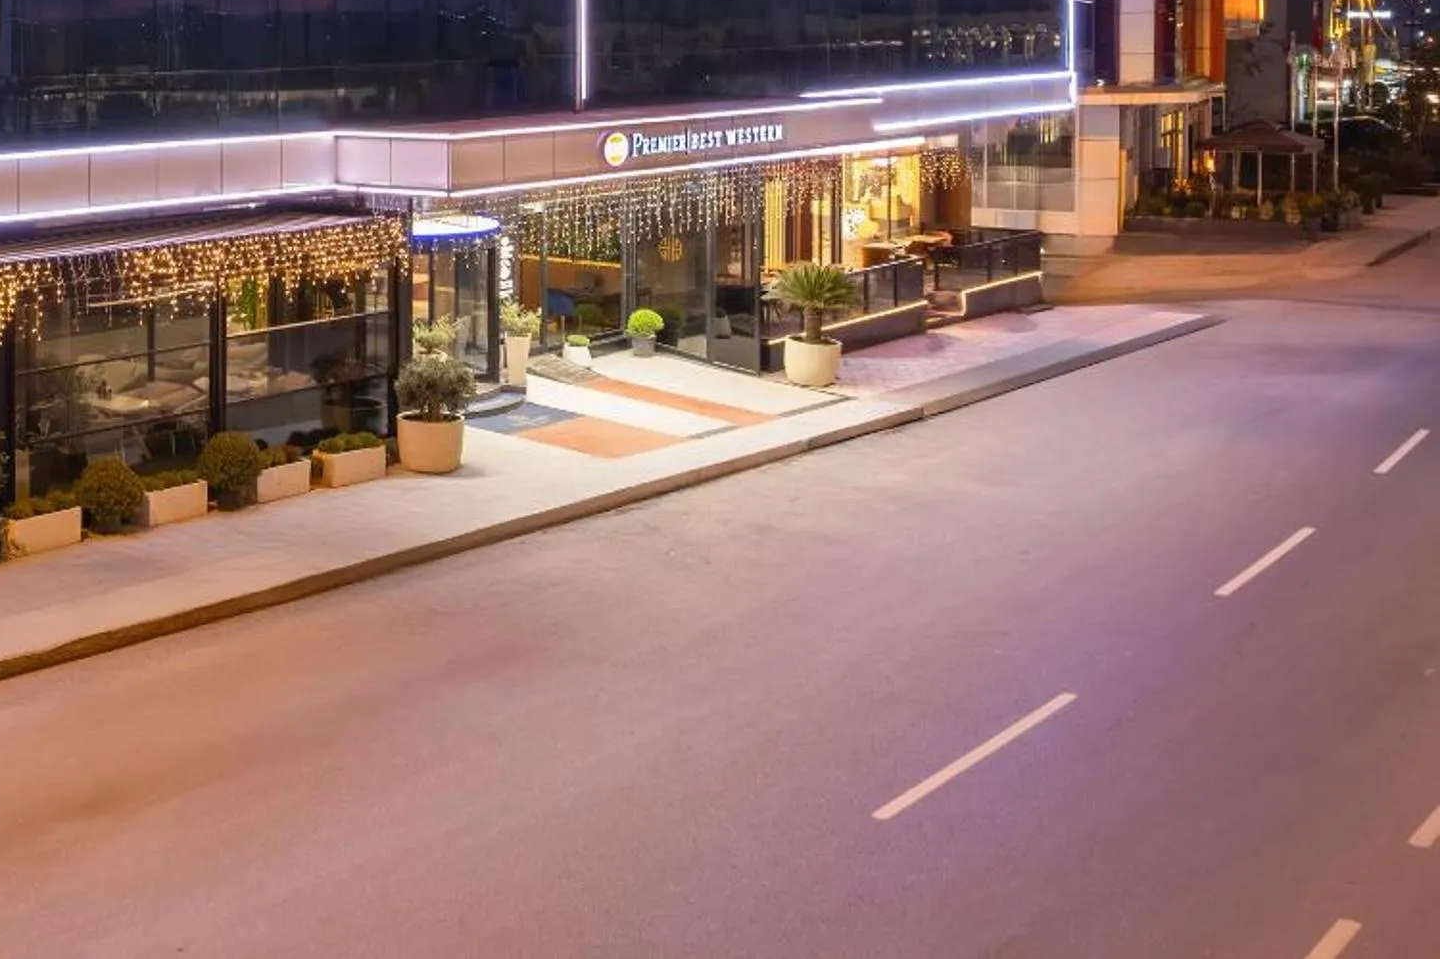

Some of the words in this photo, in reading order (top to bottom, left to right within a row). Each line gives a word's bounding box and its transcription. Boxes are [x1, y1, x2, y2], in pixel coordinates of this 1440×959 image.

[632, 132, 686, 157] PREMIER
[691, 131, 722, 150] BEST
[725, 124, 783, 146] WESTERN
